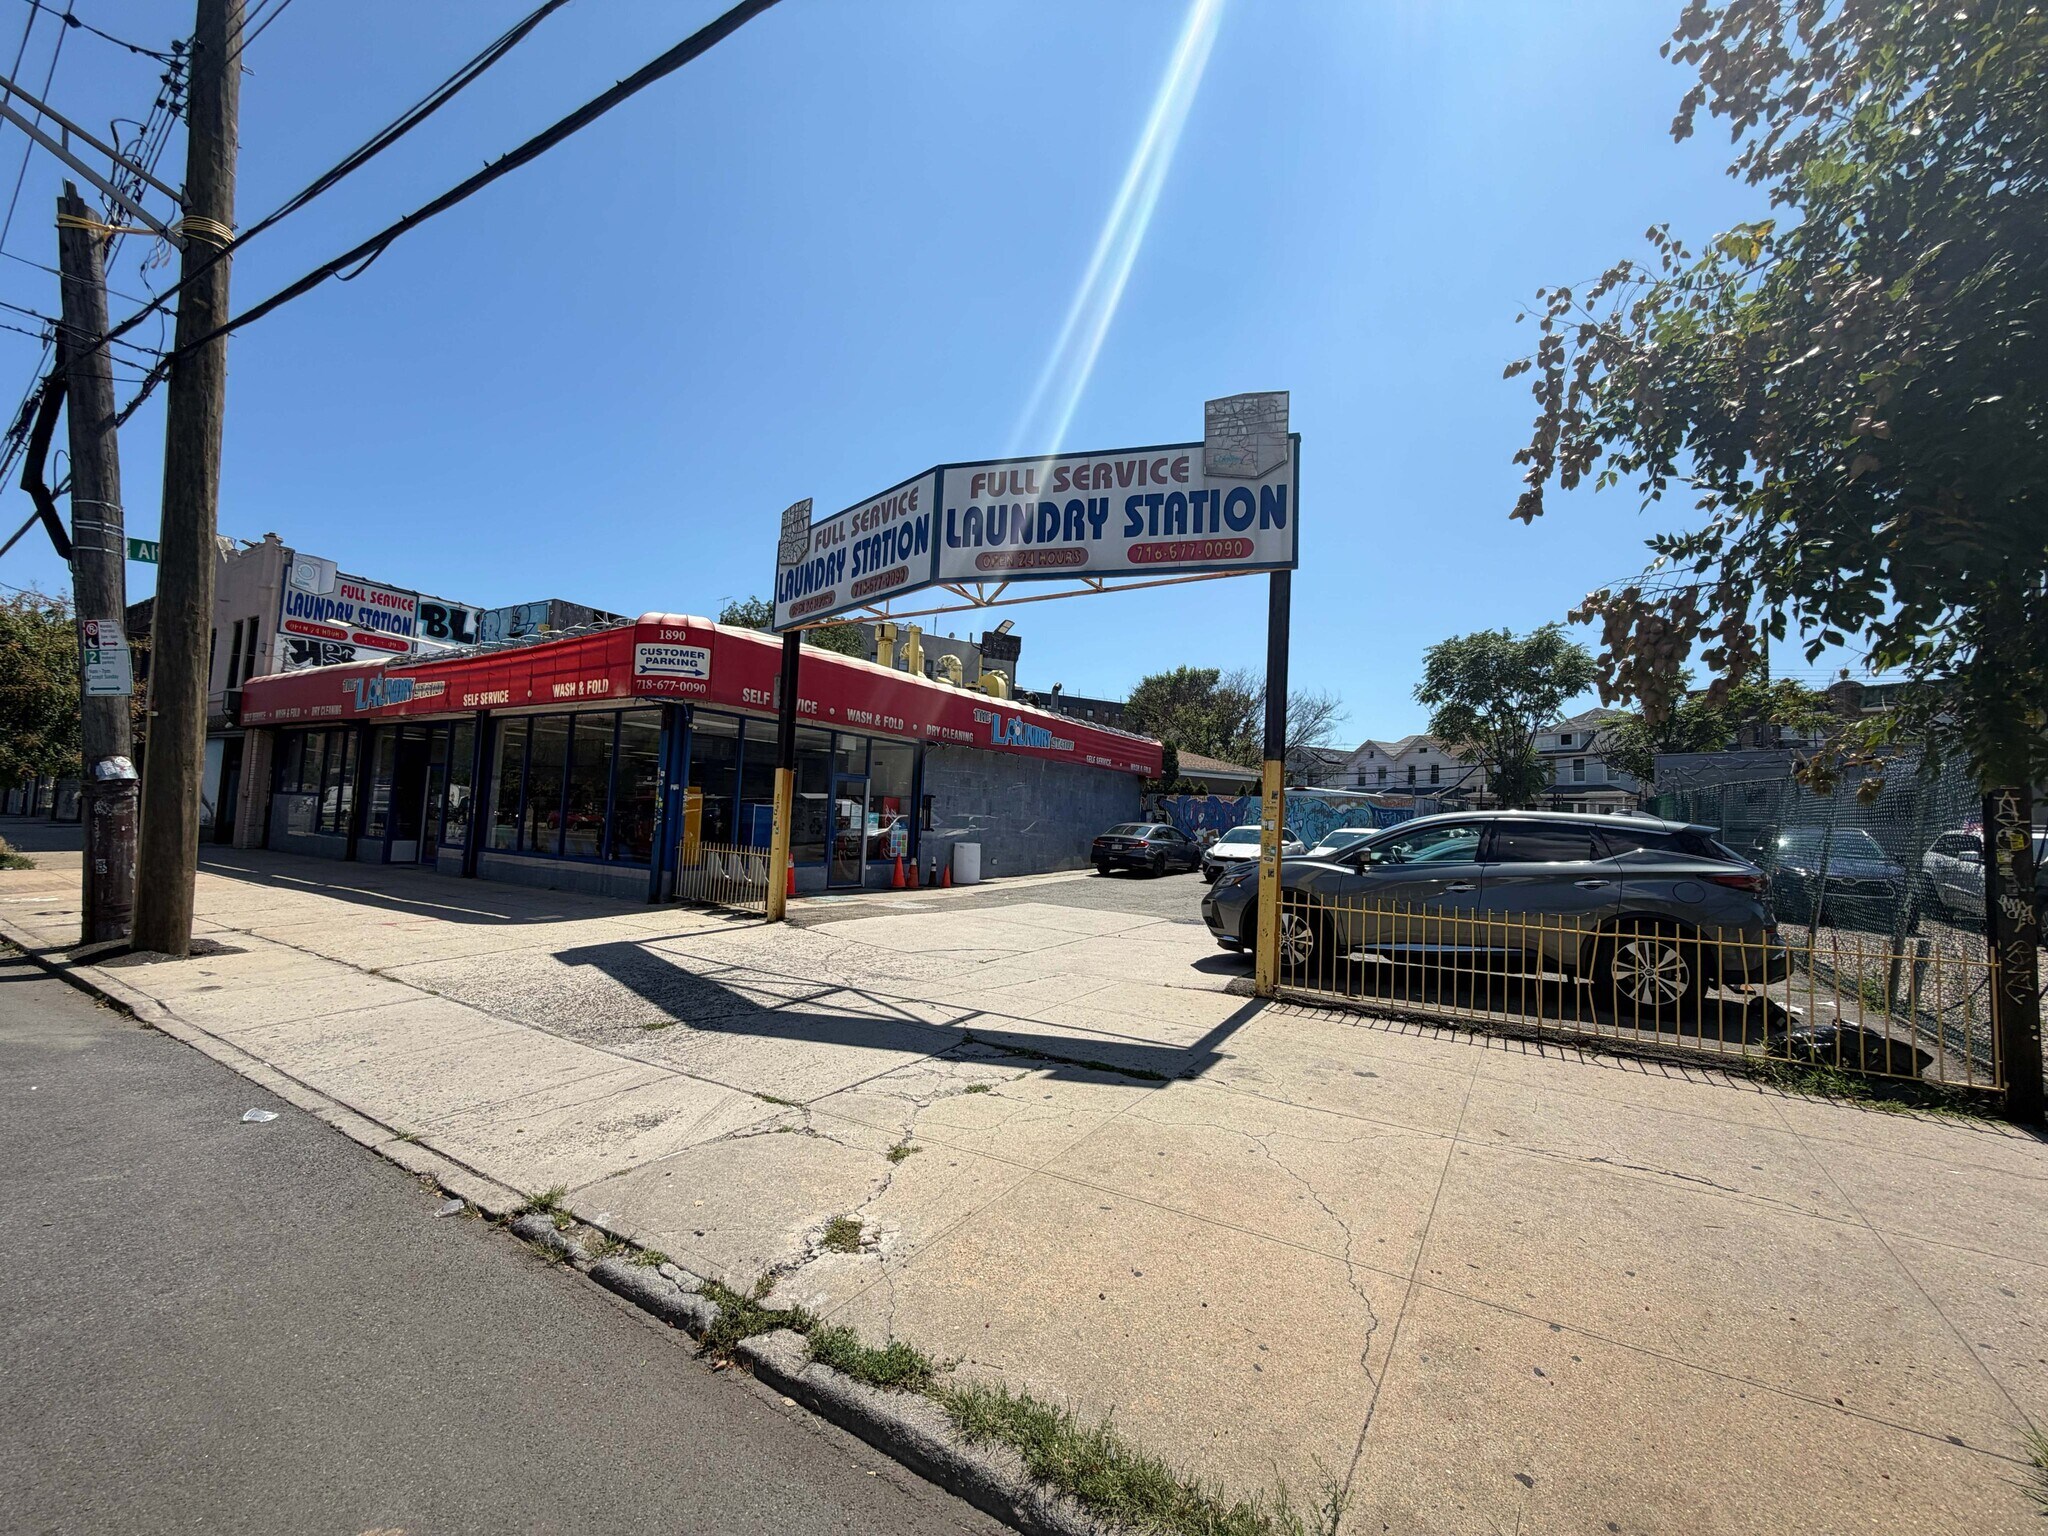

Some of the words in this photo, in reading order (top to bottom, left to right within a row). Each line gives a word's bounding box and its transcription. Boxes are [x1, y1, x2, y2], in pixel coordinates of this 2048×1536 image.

[970, 469, 1039, 499] FULL
[1053, 456, 1189, 493] SERVICE
[815, 521, 845, 553] FULL
[851, 486, 919, 538] SERVICE
[946, 497, 1109, 548] LAUNDRY
[1124, 484, 1287, 538] STATION
[778, 547, 847, 604] LAUNDRY
[852, 513, 930, 578] STATION
[983, 555, 1014, 568] OPEN
[1018, 552, 1035, 567] 24
[1038, 550, 1081, 565] HOURS
[286, 590, 354, 622] LAUNDRY
[358, 607, 412, 637] STATION
[341, 584, 366, 602] FULL
[370, 591, 414, 612] SERVICE
[659, 629, 686, 641] 1890
[89, 651, 98, 663] 2
[640, 647, 705, 660] CUSTOMER
[645, 657, 698, 668] PARKING
[354, 676, 416, 712] LAUNDRY
[463, 693, 479, 707] SELF
[480, 690, 509, 705] SERVICE
[552, 682, 576, 698] WASH
[578, 682, 584, 696] &
[587, 678, 609, 695] FOLD
[636, 679, 707, 694] 718-677-0090
[742, 687, 770, 706] SELF
[847, 708, 873, 724] WASH
[874, 714, 881, 726] &
[883, 716, 904, 730] FOLD
[926, 724, 941, 737] DRY
[942, 726, 974, 743] CLEANING
[991, 712, 1052, 749] LAUNDRY
